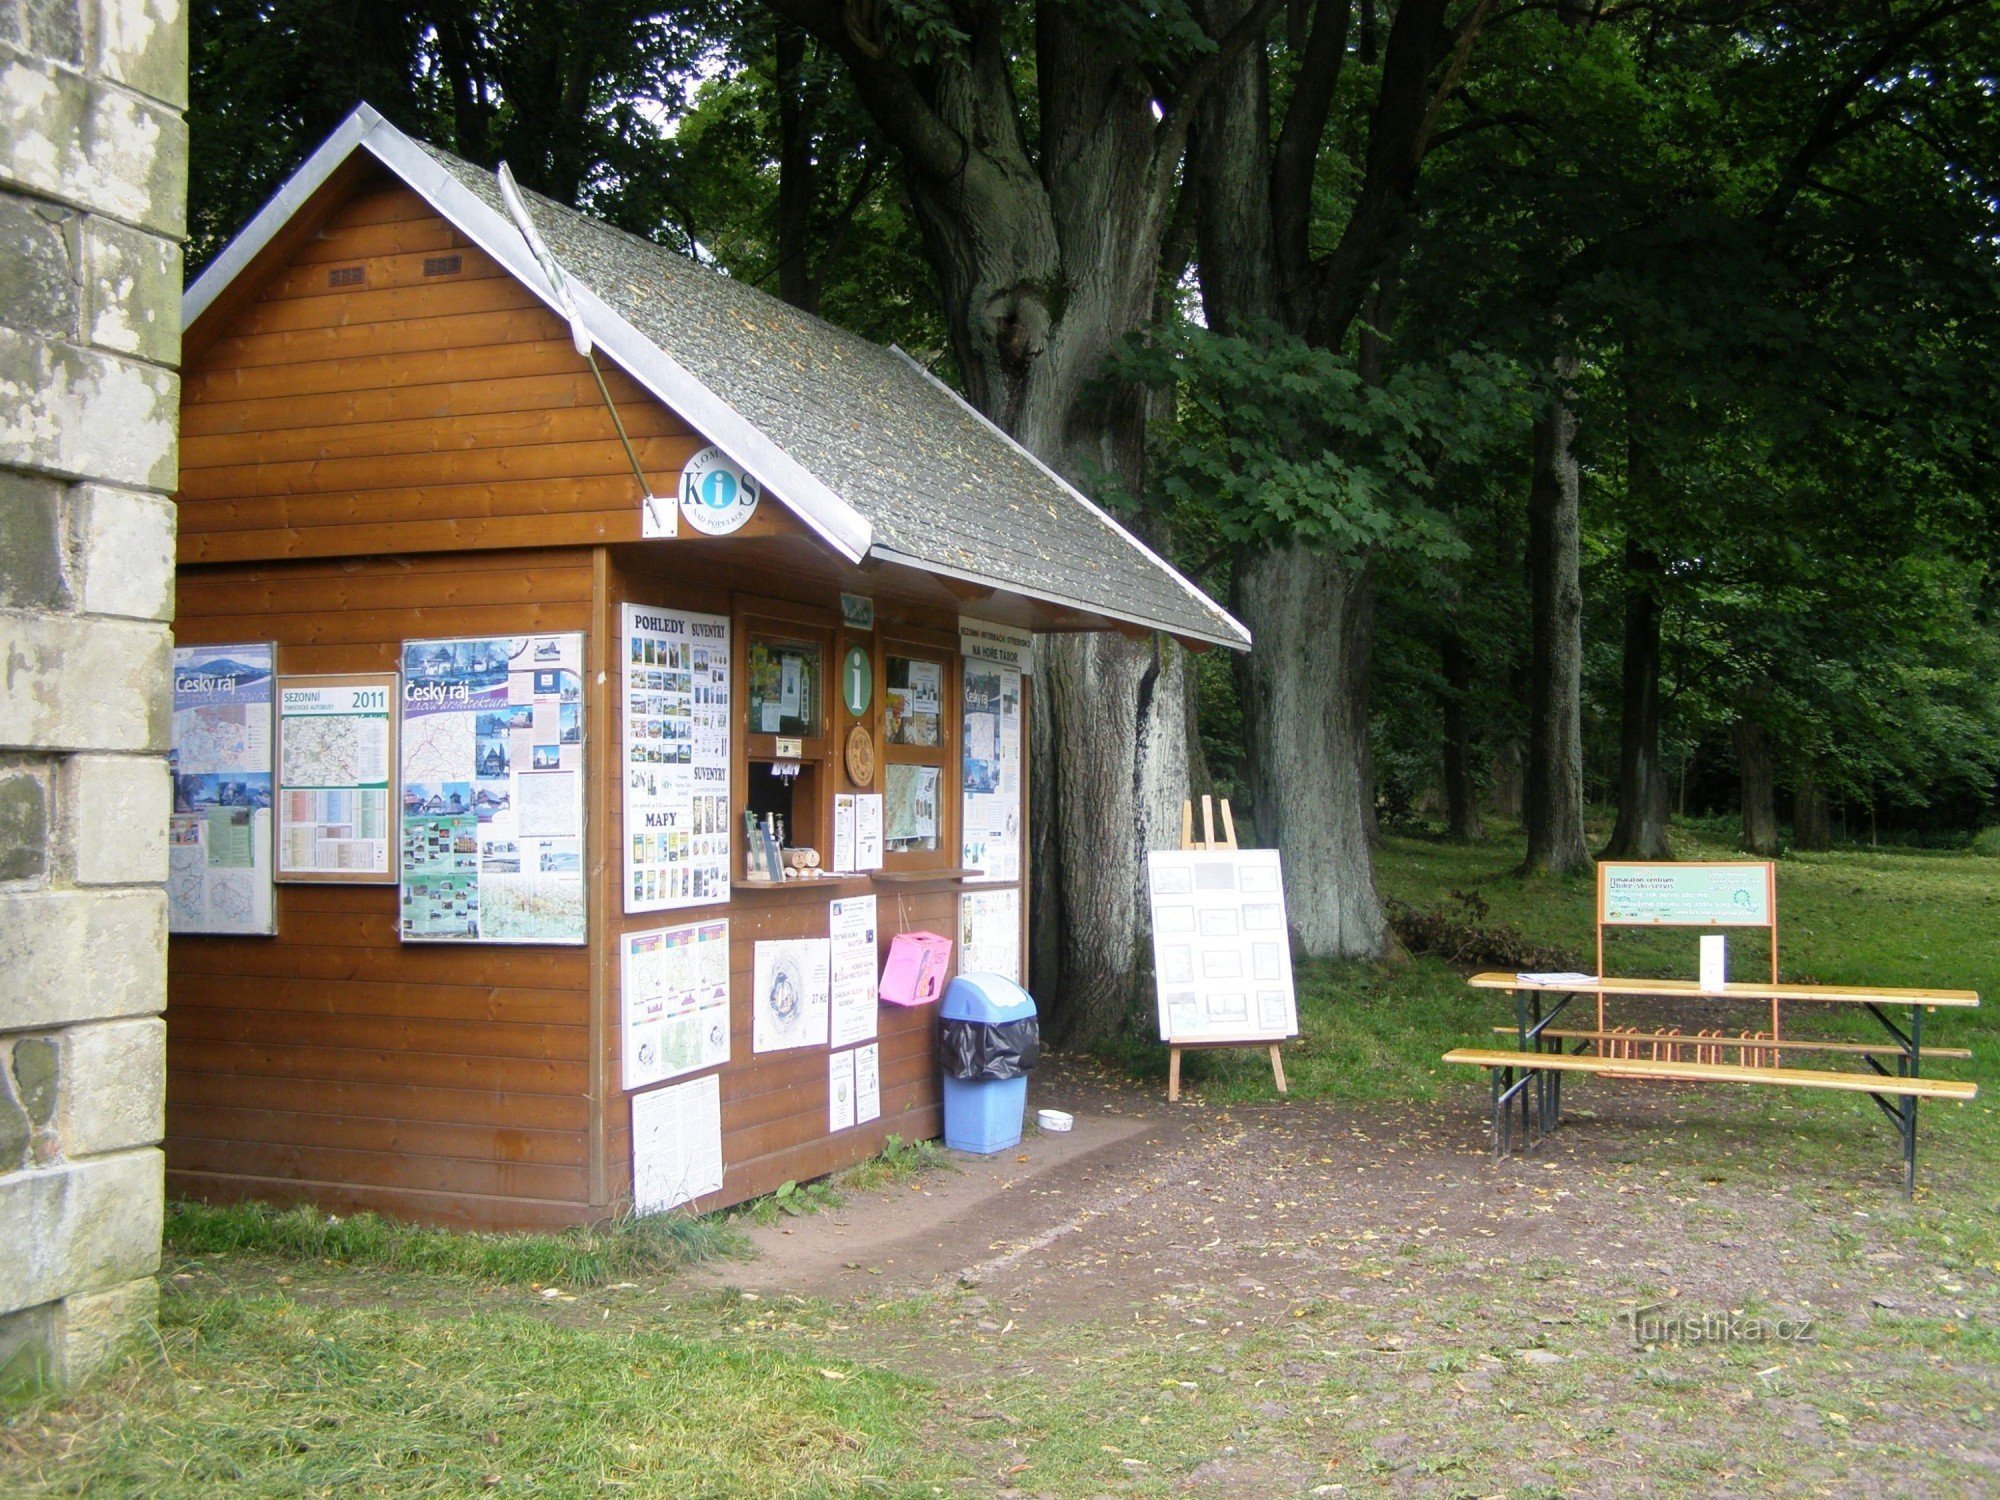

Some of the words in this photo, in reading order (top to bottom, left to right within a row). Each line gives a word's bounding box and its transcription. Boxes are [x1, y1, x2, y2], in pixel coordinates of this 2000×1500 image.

[634, 614, 685, 634] POHLEDY
[691, 621, 726, 639] SUVENÝRY
[972, 644, 981, 656] NA
[176, 673, 215, 696] Český
[217, 673, 236, 695] ráj
[405, 680, 447, 705] Český
[449, 680, 469, 704] ráj
[284, 690, 321, 703] SEZONNÍ
[352, 691, 385, 709] 2011
[694, 763, 727, 781] SUVENÝRY
[645, 812, 677, 827] MAPY
[811, 993, 819, 1005] 27
